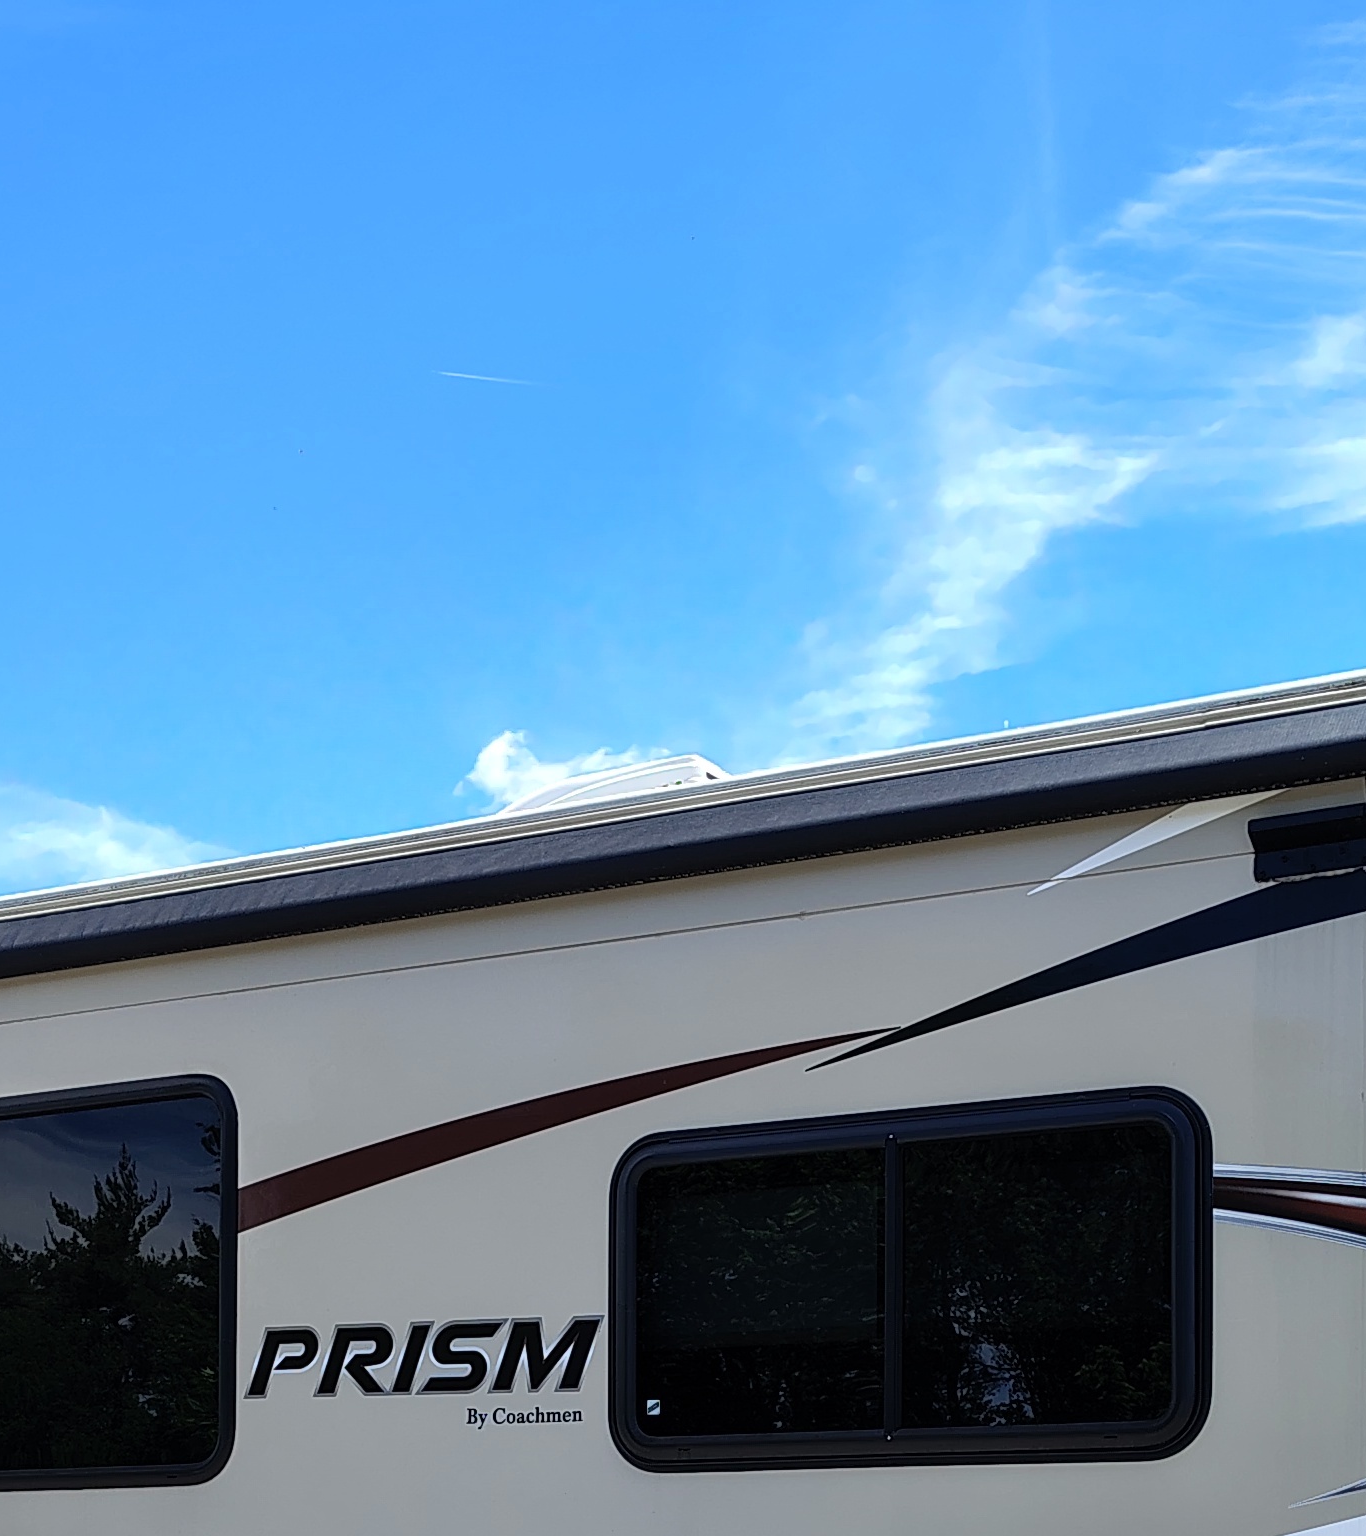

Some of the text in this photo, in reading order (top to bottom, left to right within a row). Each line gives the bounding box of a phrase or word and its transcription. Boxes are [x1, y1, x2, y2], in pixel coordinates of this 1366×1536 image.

[243, 1315, 605, 1399] PRISM
[466, 1407, 583, 1429] By Coachmen
